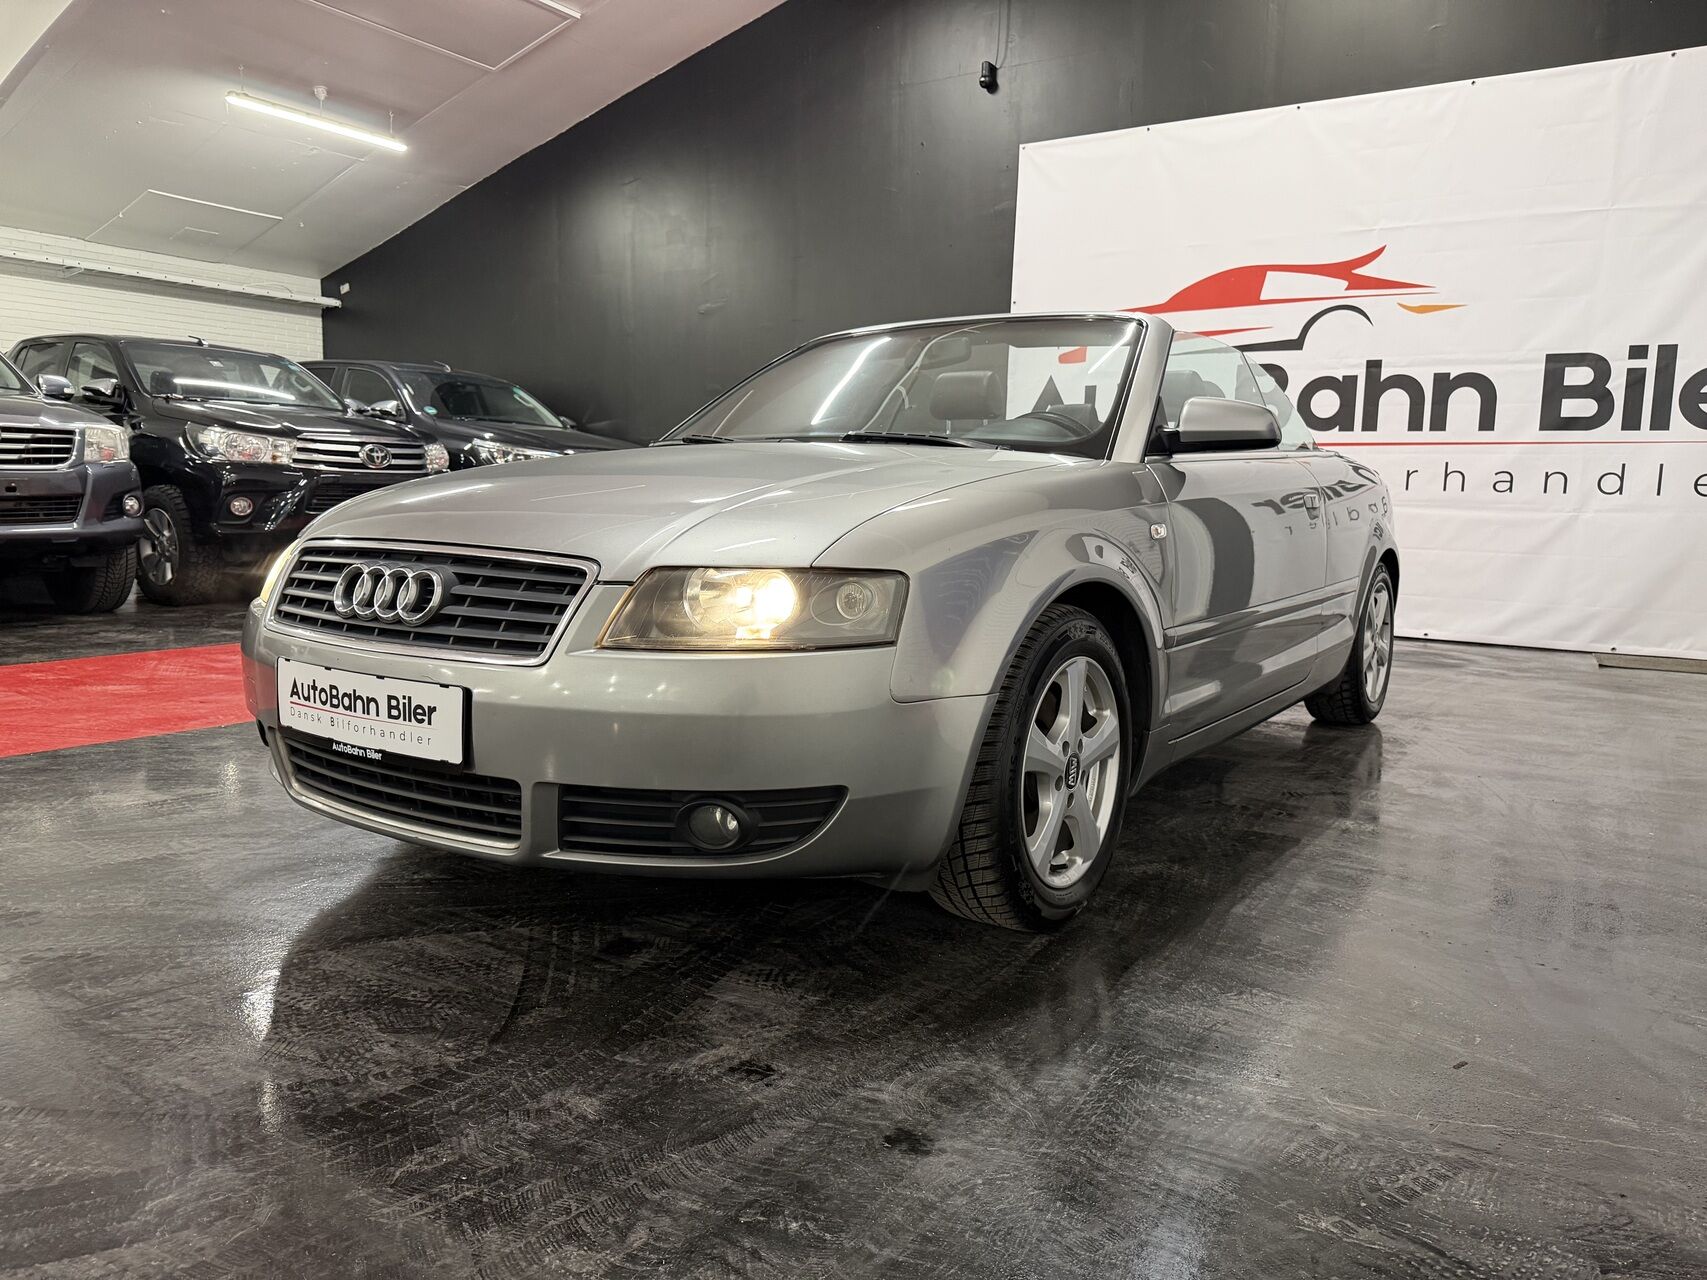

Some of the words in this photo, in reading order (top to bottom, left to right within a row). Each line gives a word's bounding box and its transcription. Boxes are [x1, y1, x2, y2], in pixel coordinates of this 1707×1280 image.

[1030, 359, 1498, 432] ABahn
[289, 677, 380, 718] AutoBahn
[386, 694, 437, 726] Biler
[290, 706, 322, 724] Dansk
[330, 716, 432, 746] Bilforhandler
[332, 742, 366, 757] AutoBahn
[366, 749, 383, 761] Biler
